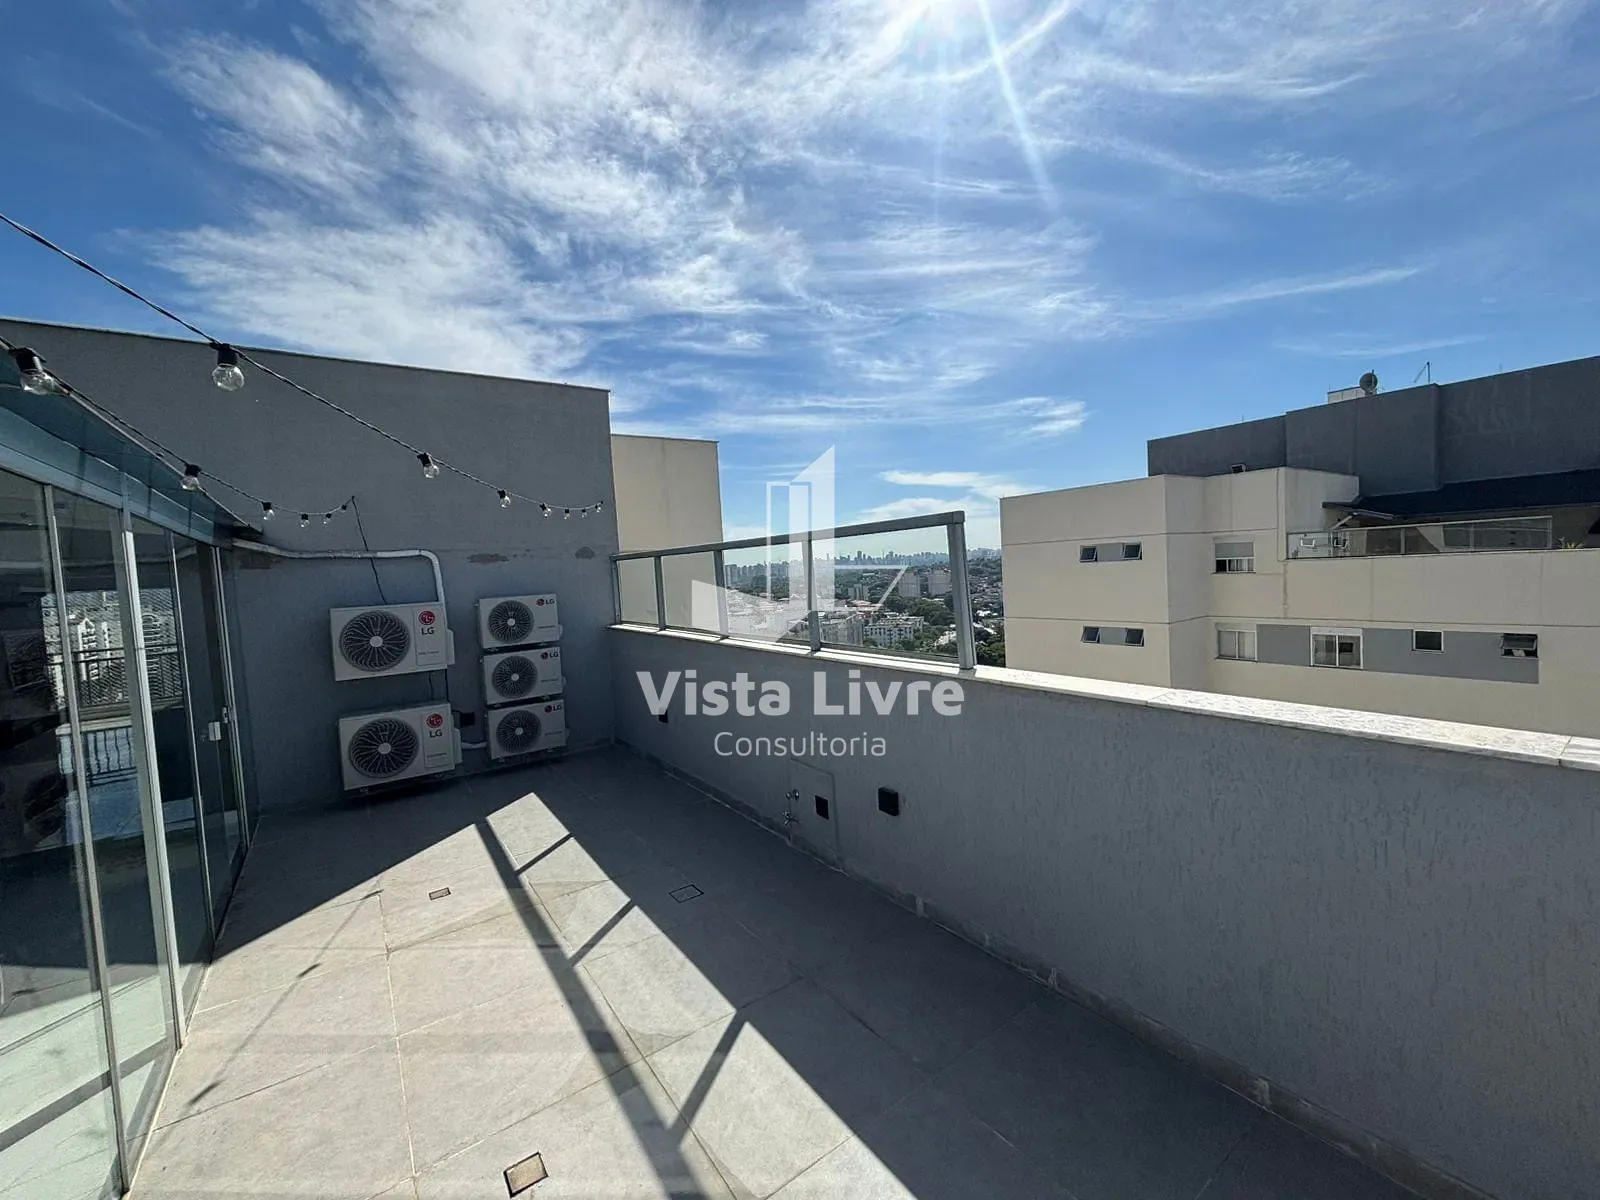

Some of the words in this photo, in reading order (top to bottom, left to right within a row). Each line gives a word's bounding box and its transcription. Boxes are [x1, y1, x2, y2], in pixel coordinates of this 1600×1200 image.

[545, 598, 555, 606] LG
[421, 626, 435, 636] LG
[549, 651, 559, 659] LG
[429, 729, 443, 738] LG
